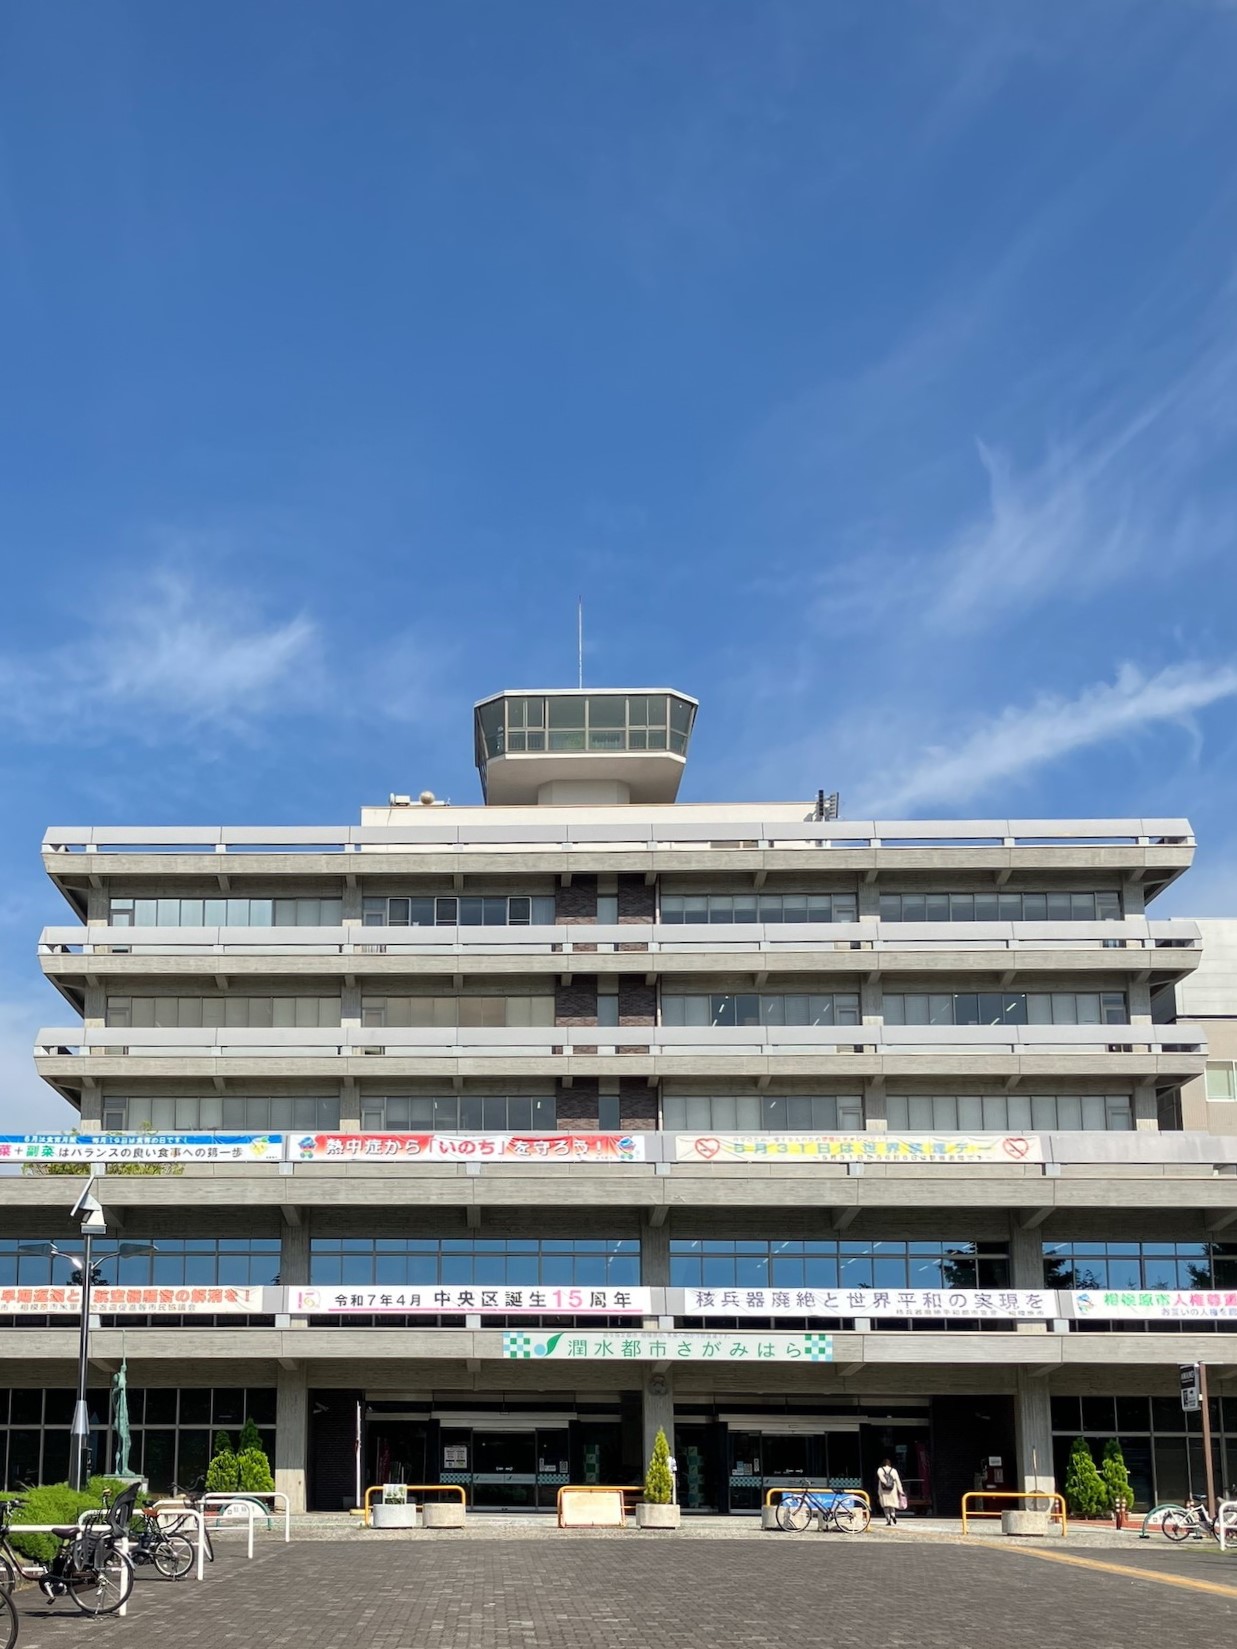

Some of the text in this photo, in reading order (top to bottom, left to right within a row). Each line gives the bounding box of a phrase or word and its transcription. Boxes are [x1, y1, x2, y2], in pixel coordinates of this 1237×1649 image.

[335, 1290, 631, 1308] 令和7年4月 中央区誕生15周年
[696, 1291, 1043, 1309] 核兵器廃絶と世界平和の実現を
[568, 1339, 802, 1358] 潤水都市さがみはら
